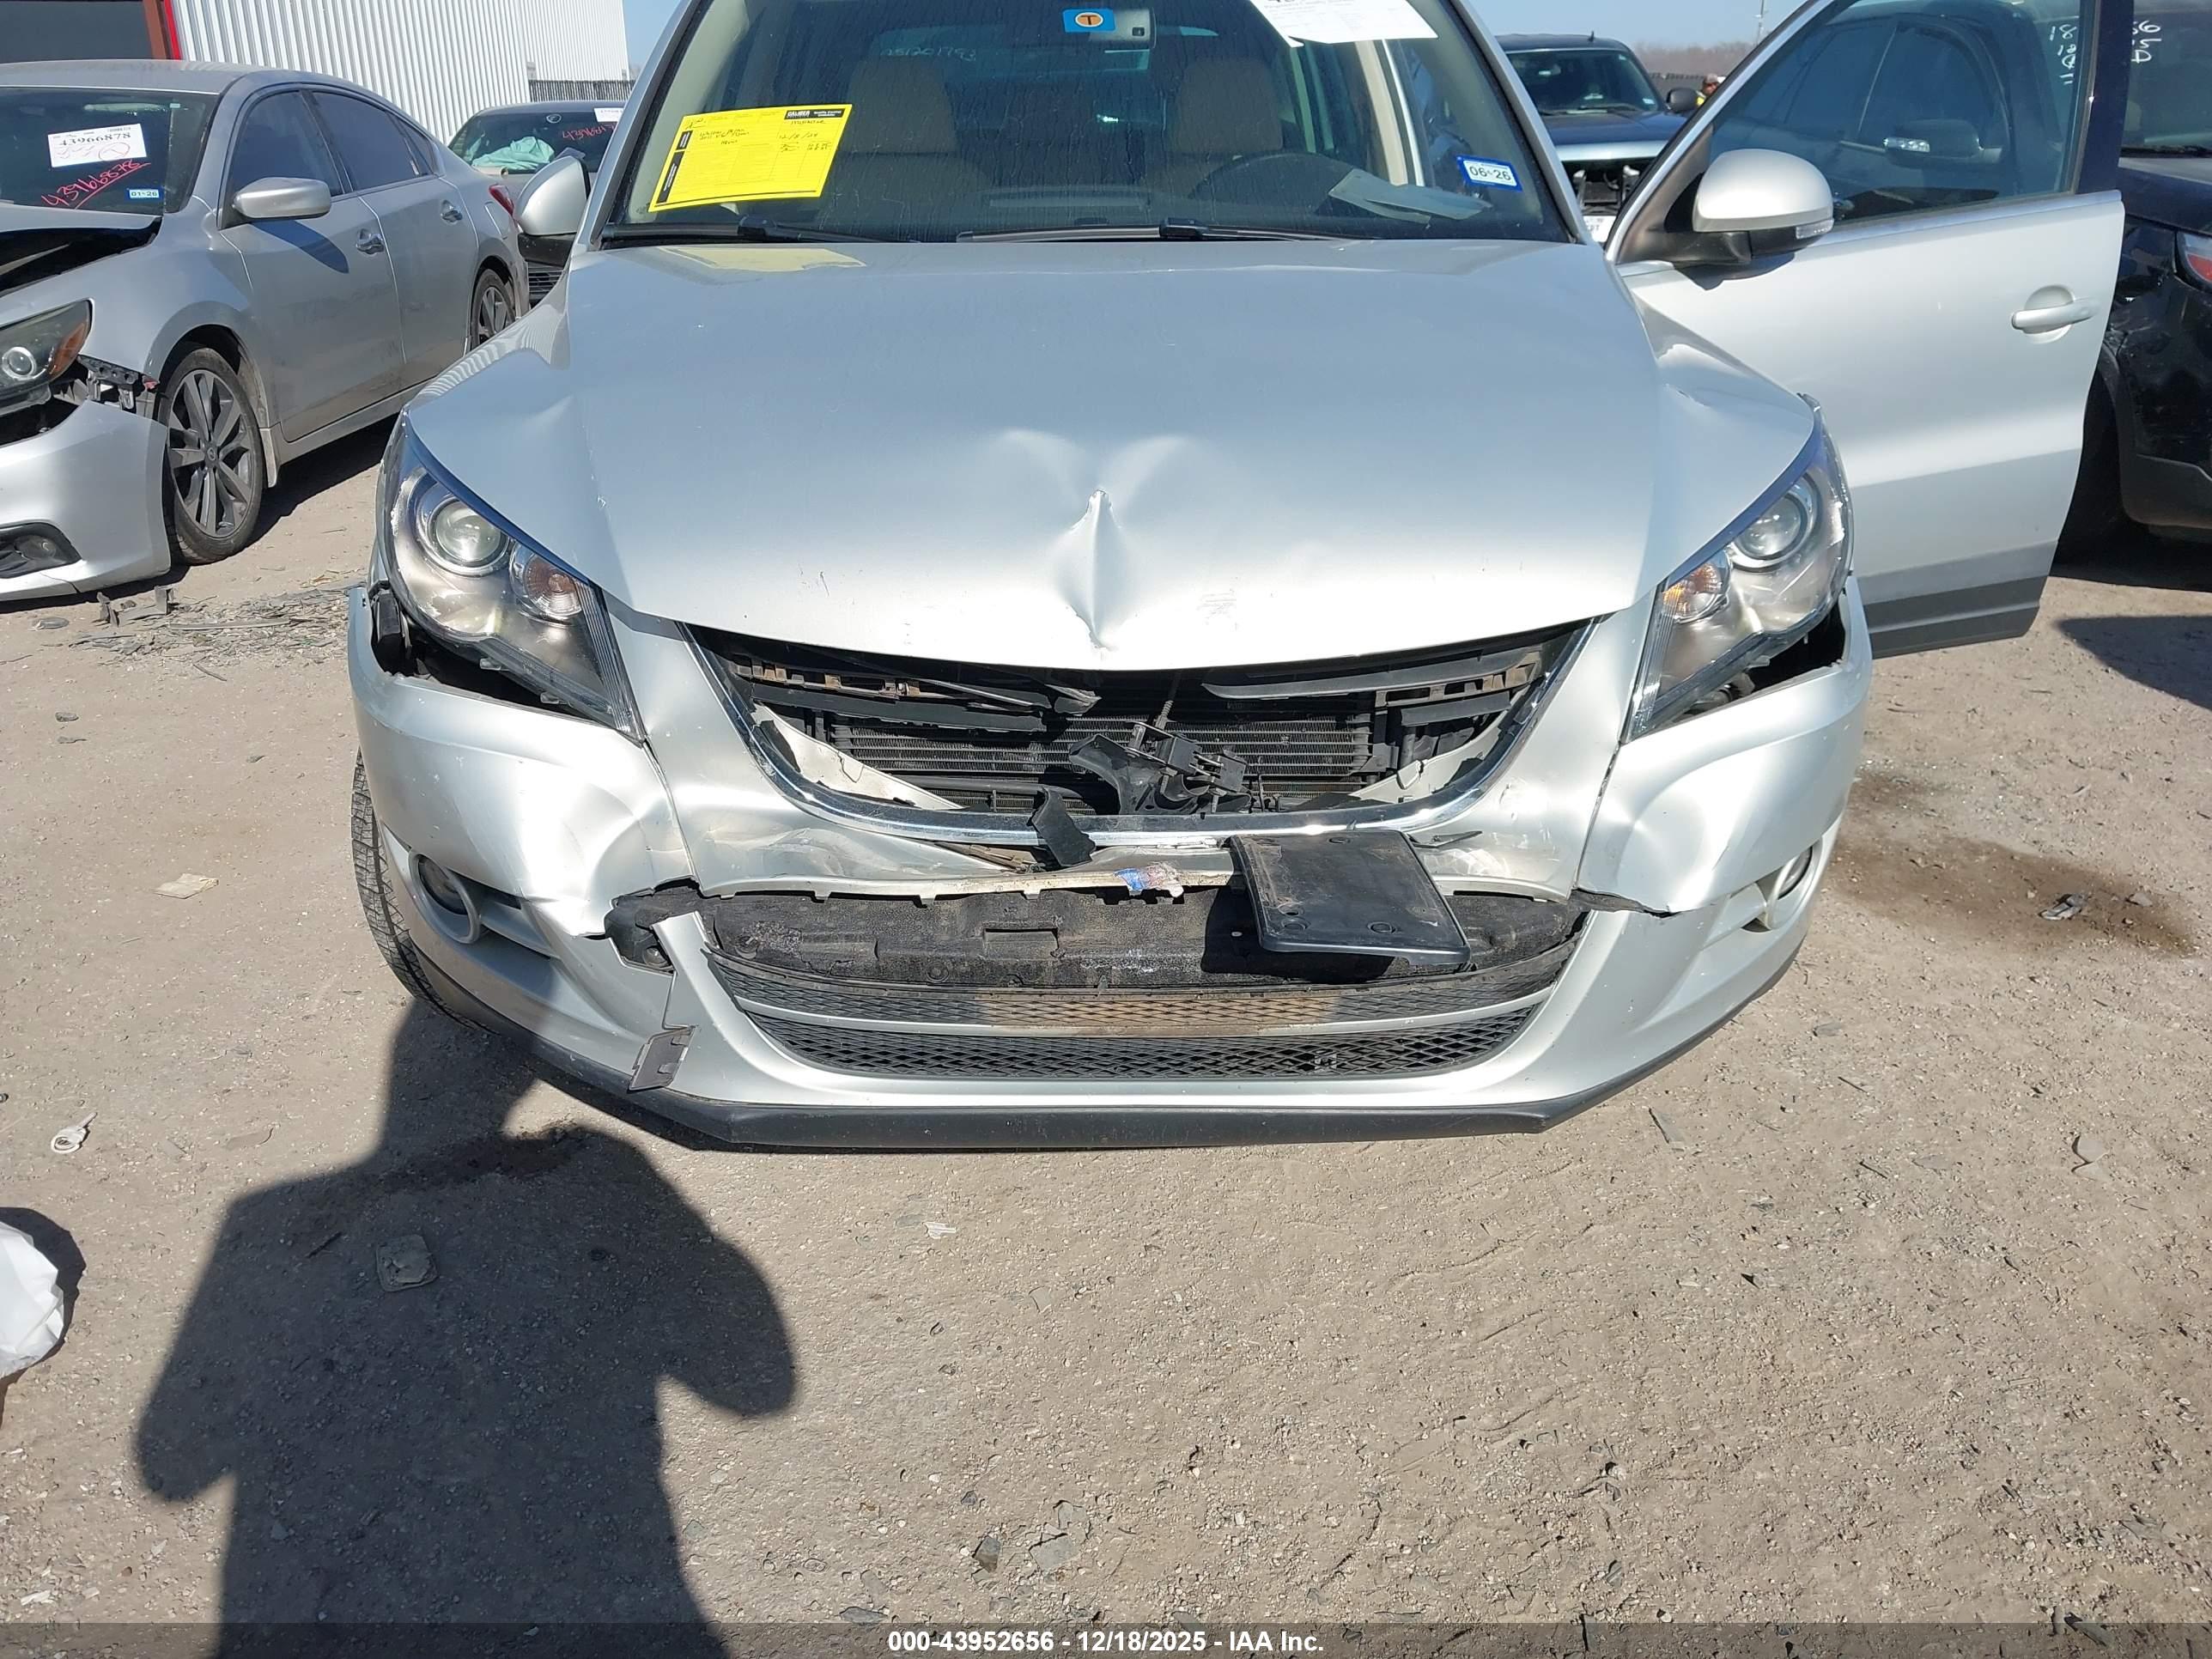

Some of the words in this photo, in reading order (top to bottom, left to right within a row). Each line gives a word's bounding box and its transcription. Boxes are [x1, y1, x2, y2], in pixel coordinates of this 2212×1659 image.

[1080, 15, 1097, 26] T
[60, 132, 131, 145] 43966878
[41, 159, 140, 206] 43966878
